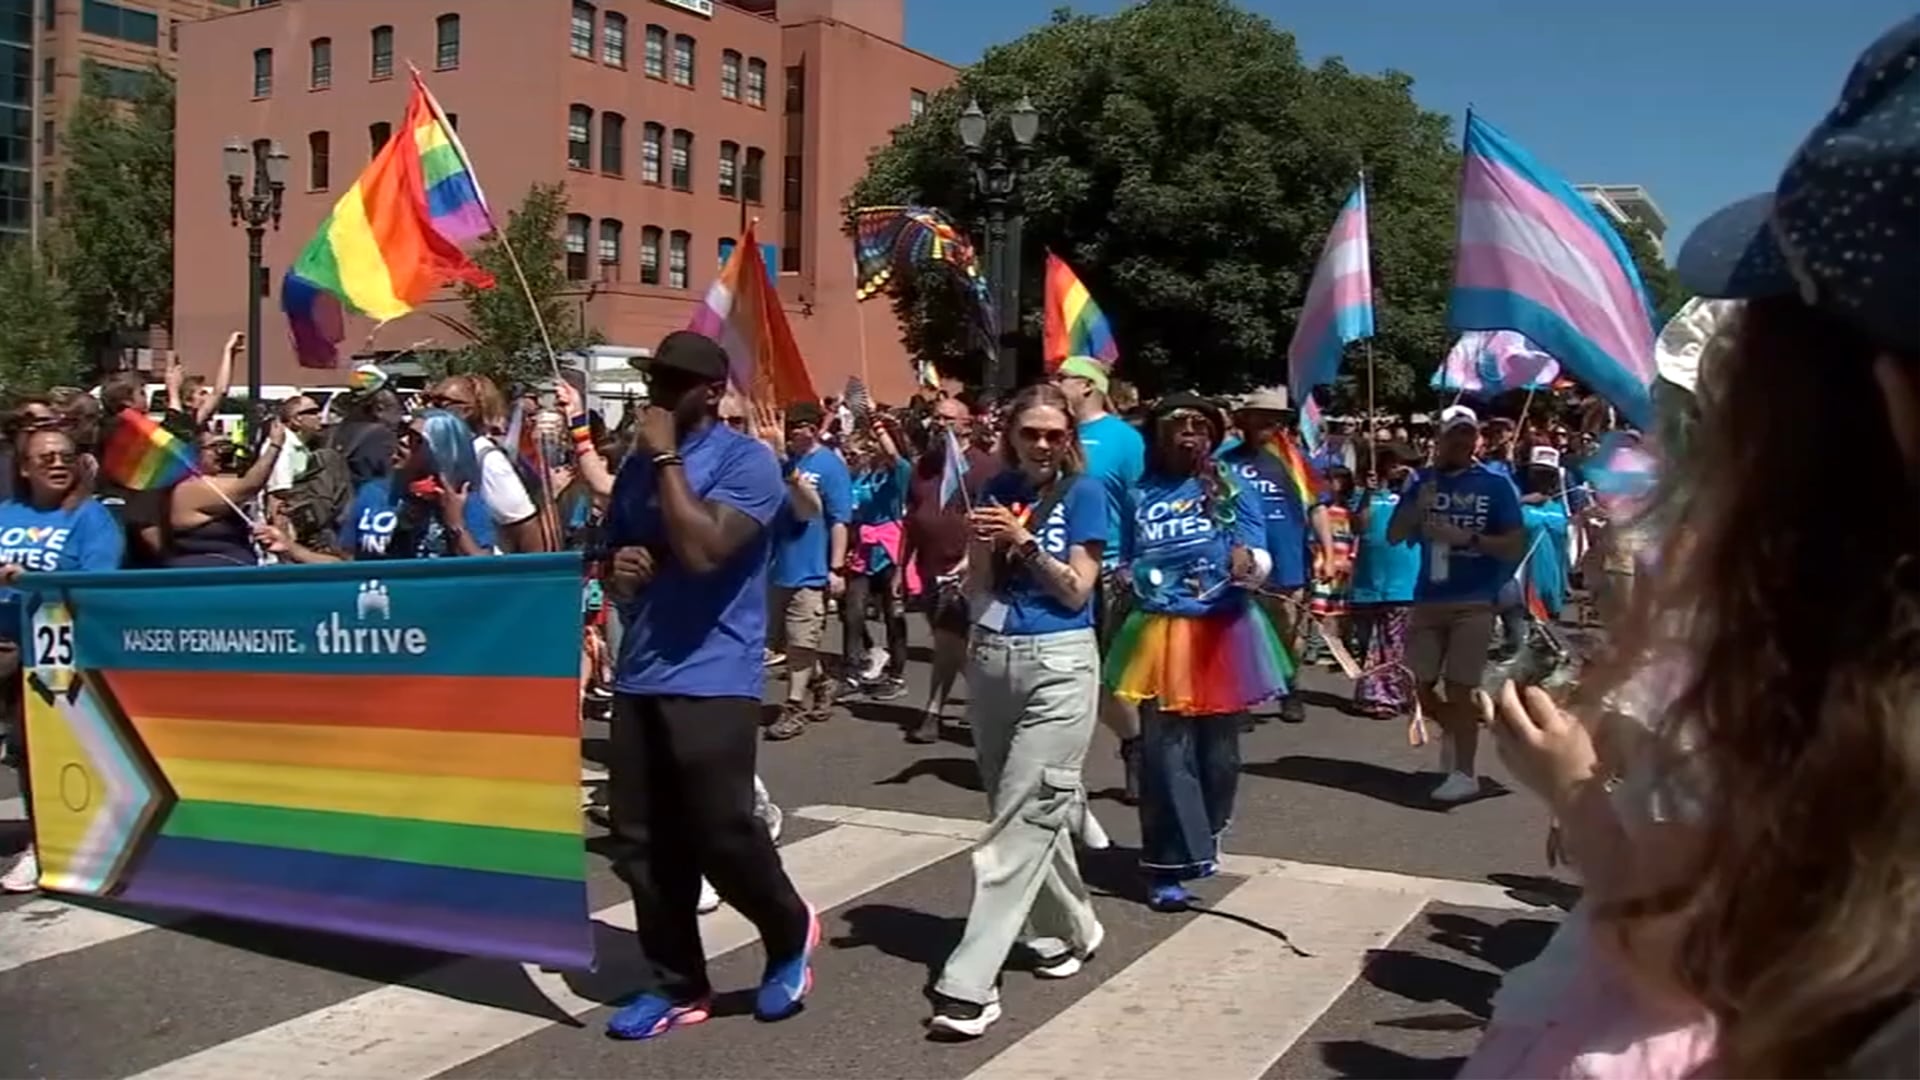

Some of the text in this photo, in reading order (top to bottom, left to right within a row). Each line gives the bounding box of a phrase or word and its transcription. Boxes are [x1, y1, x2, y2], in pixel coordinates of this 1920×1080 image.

[1435, 491, 1490, 513] OVE
[0, 526, 71, 551] OVE
[38, 625, 73, 665] 25
[122, 628, 175, 652] KAISER
[316, 611, 427, 654] thrive
